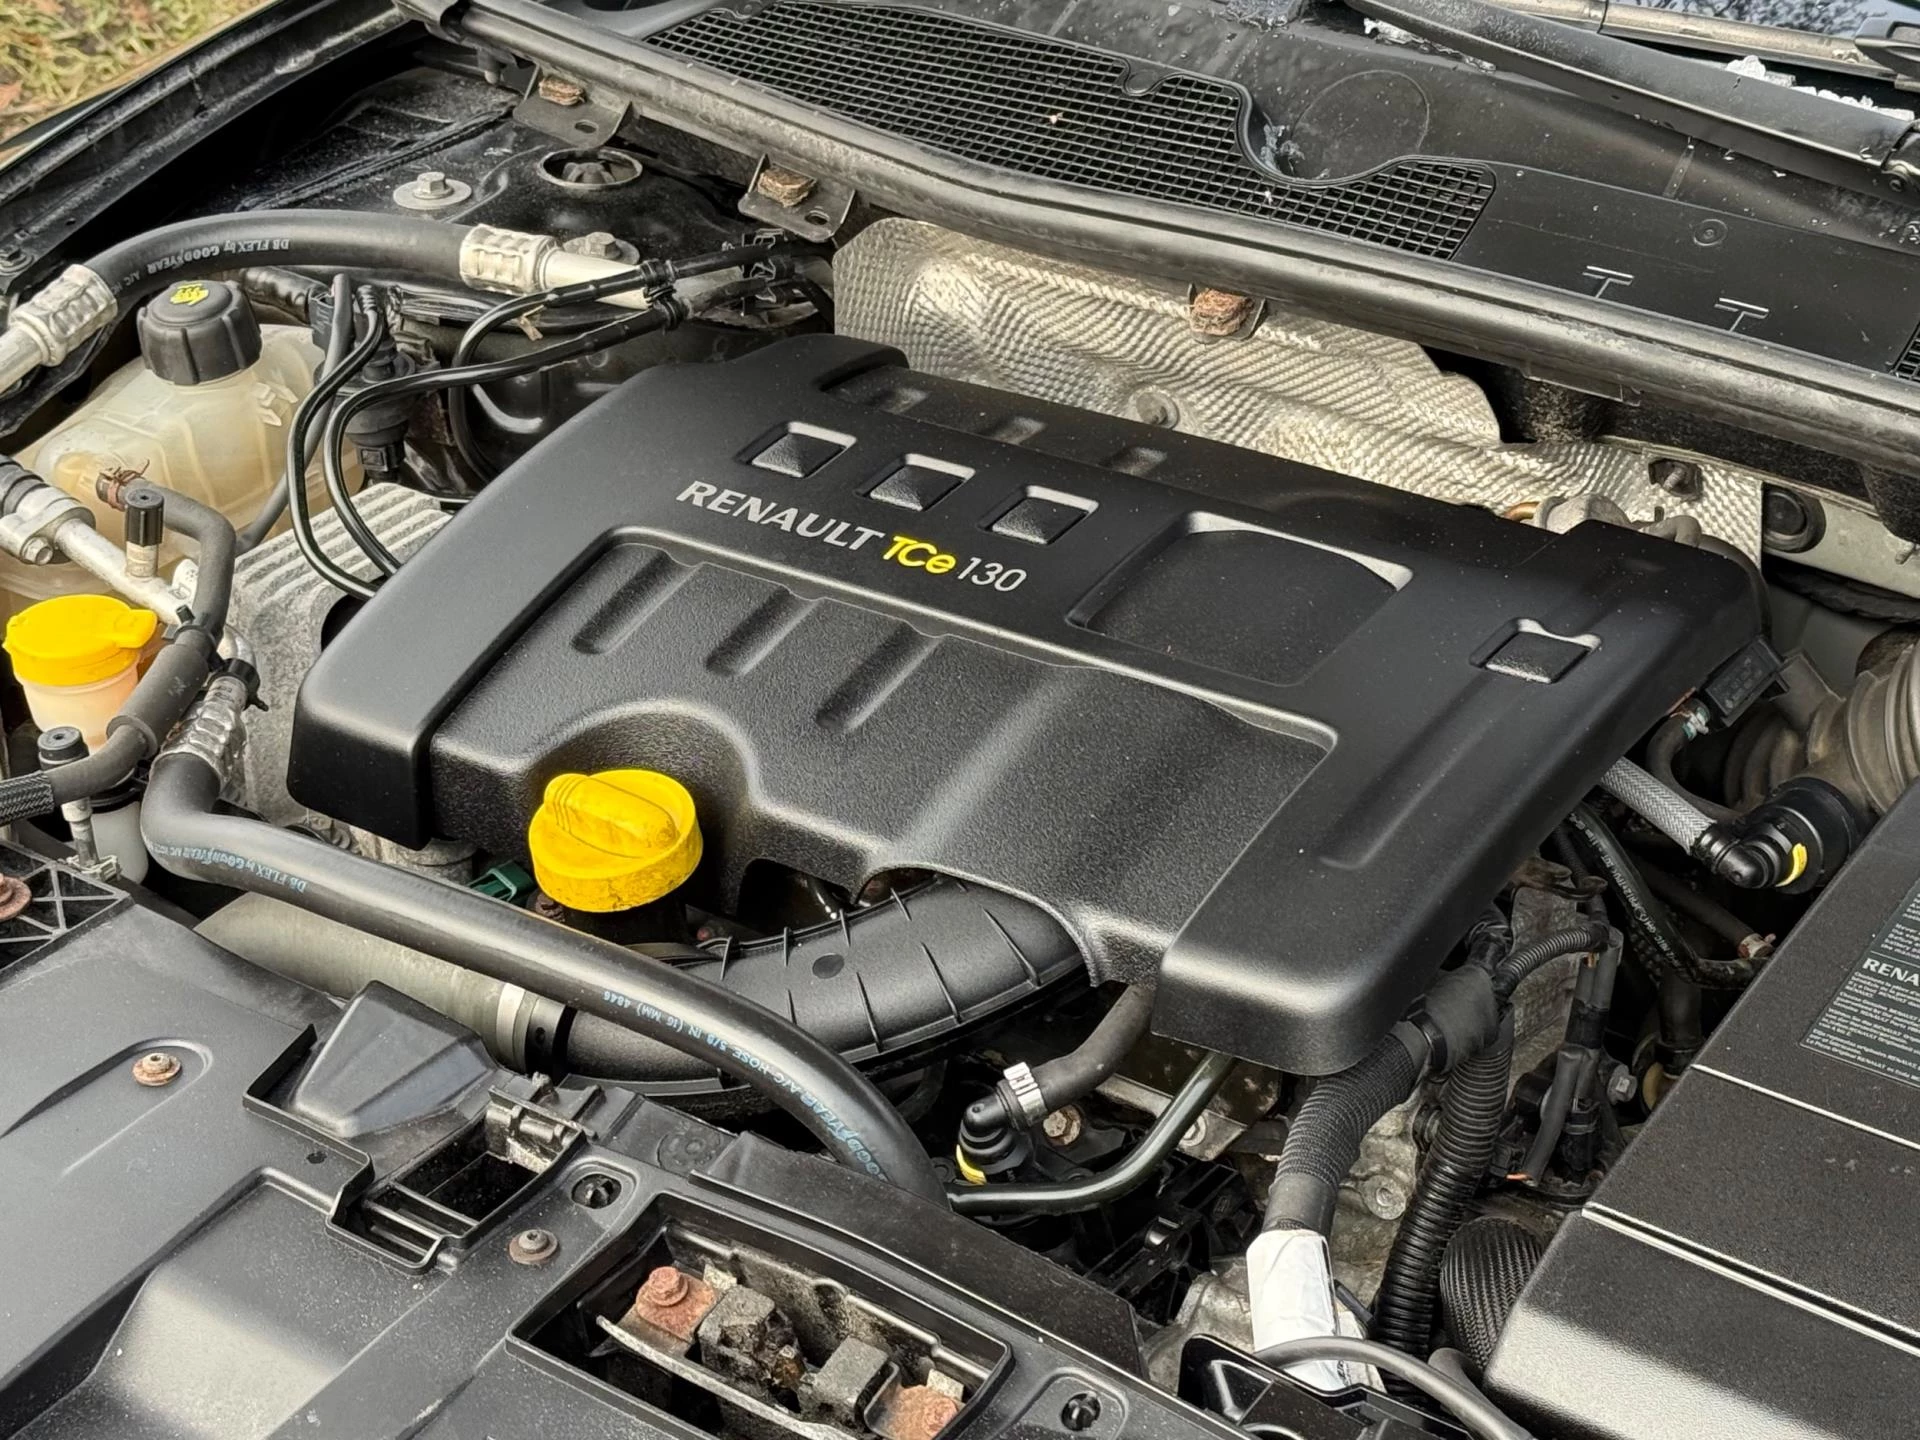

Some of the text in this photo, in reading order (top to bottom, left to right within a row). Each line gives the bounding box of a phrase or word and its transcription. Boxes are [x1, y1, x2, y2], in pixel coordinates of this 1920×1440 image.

[224, 240, 235, 253] by
[239, 239, 269, 252] FLEX
[273, 238, 290, 251] DB
[147, 245, 220, 274] GOODYEAR
[675, 480, 1027, 592] RENAULT TCe 130
[256, 864, 288, 885] FLEX
[603, 990, 631, 1008] 4846
[636, 1002, 662, 1023] MM)
[666, 1016, 684, 1032] (16
[688, 1025, 704, 1039] IN
[706, 1033, 728, 1051] 5/8
[732, 1047, 770, 1075] HOSE
[773, 1072, 801, 1093] A/C
